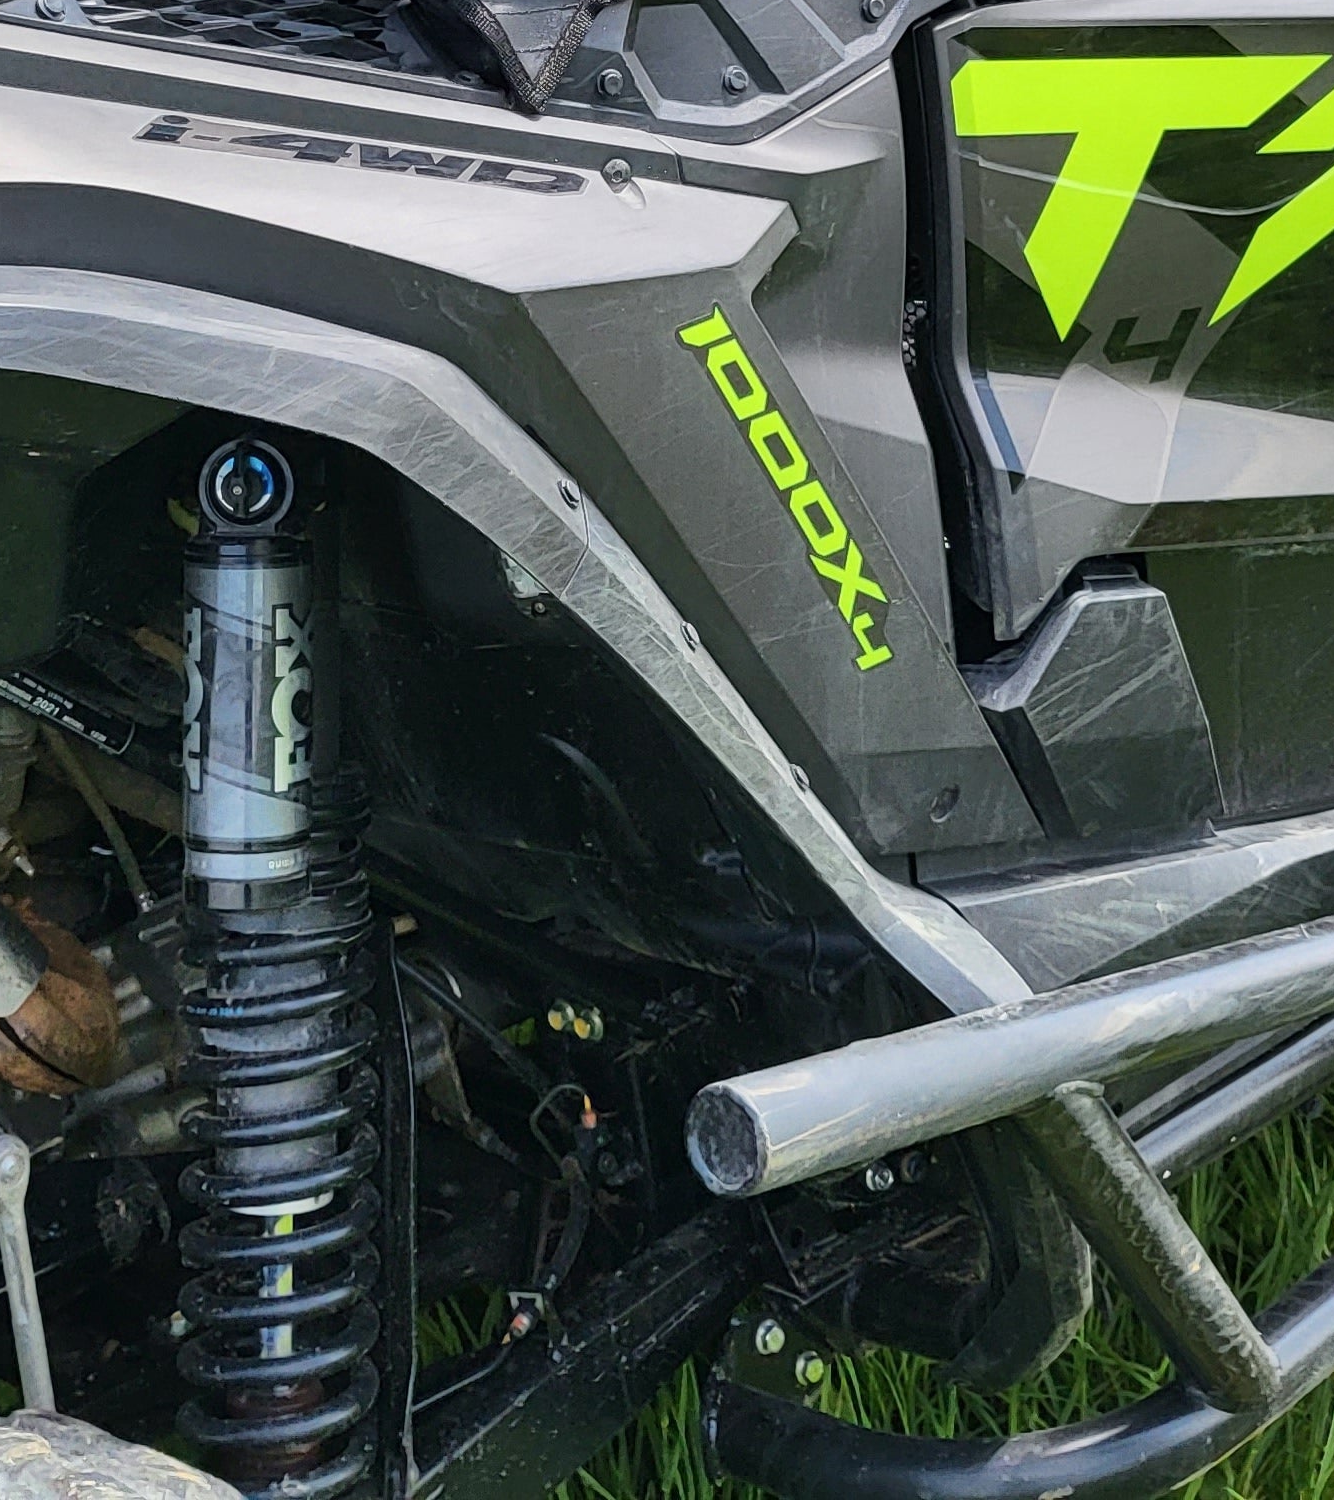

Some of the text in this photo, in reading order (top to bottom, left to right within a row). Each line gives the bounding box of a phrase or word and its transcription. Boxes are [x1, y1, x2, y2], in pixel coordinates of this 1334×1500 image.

[136, 114, 587, 194] i-4WD
[1102, 305, 1203, 384] 4
[32, 696, 60, 717] 2021
